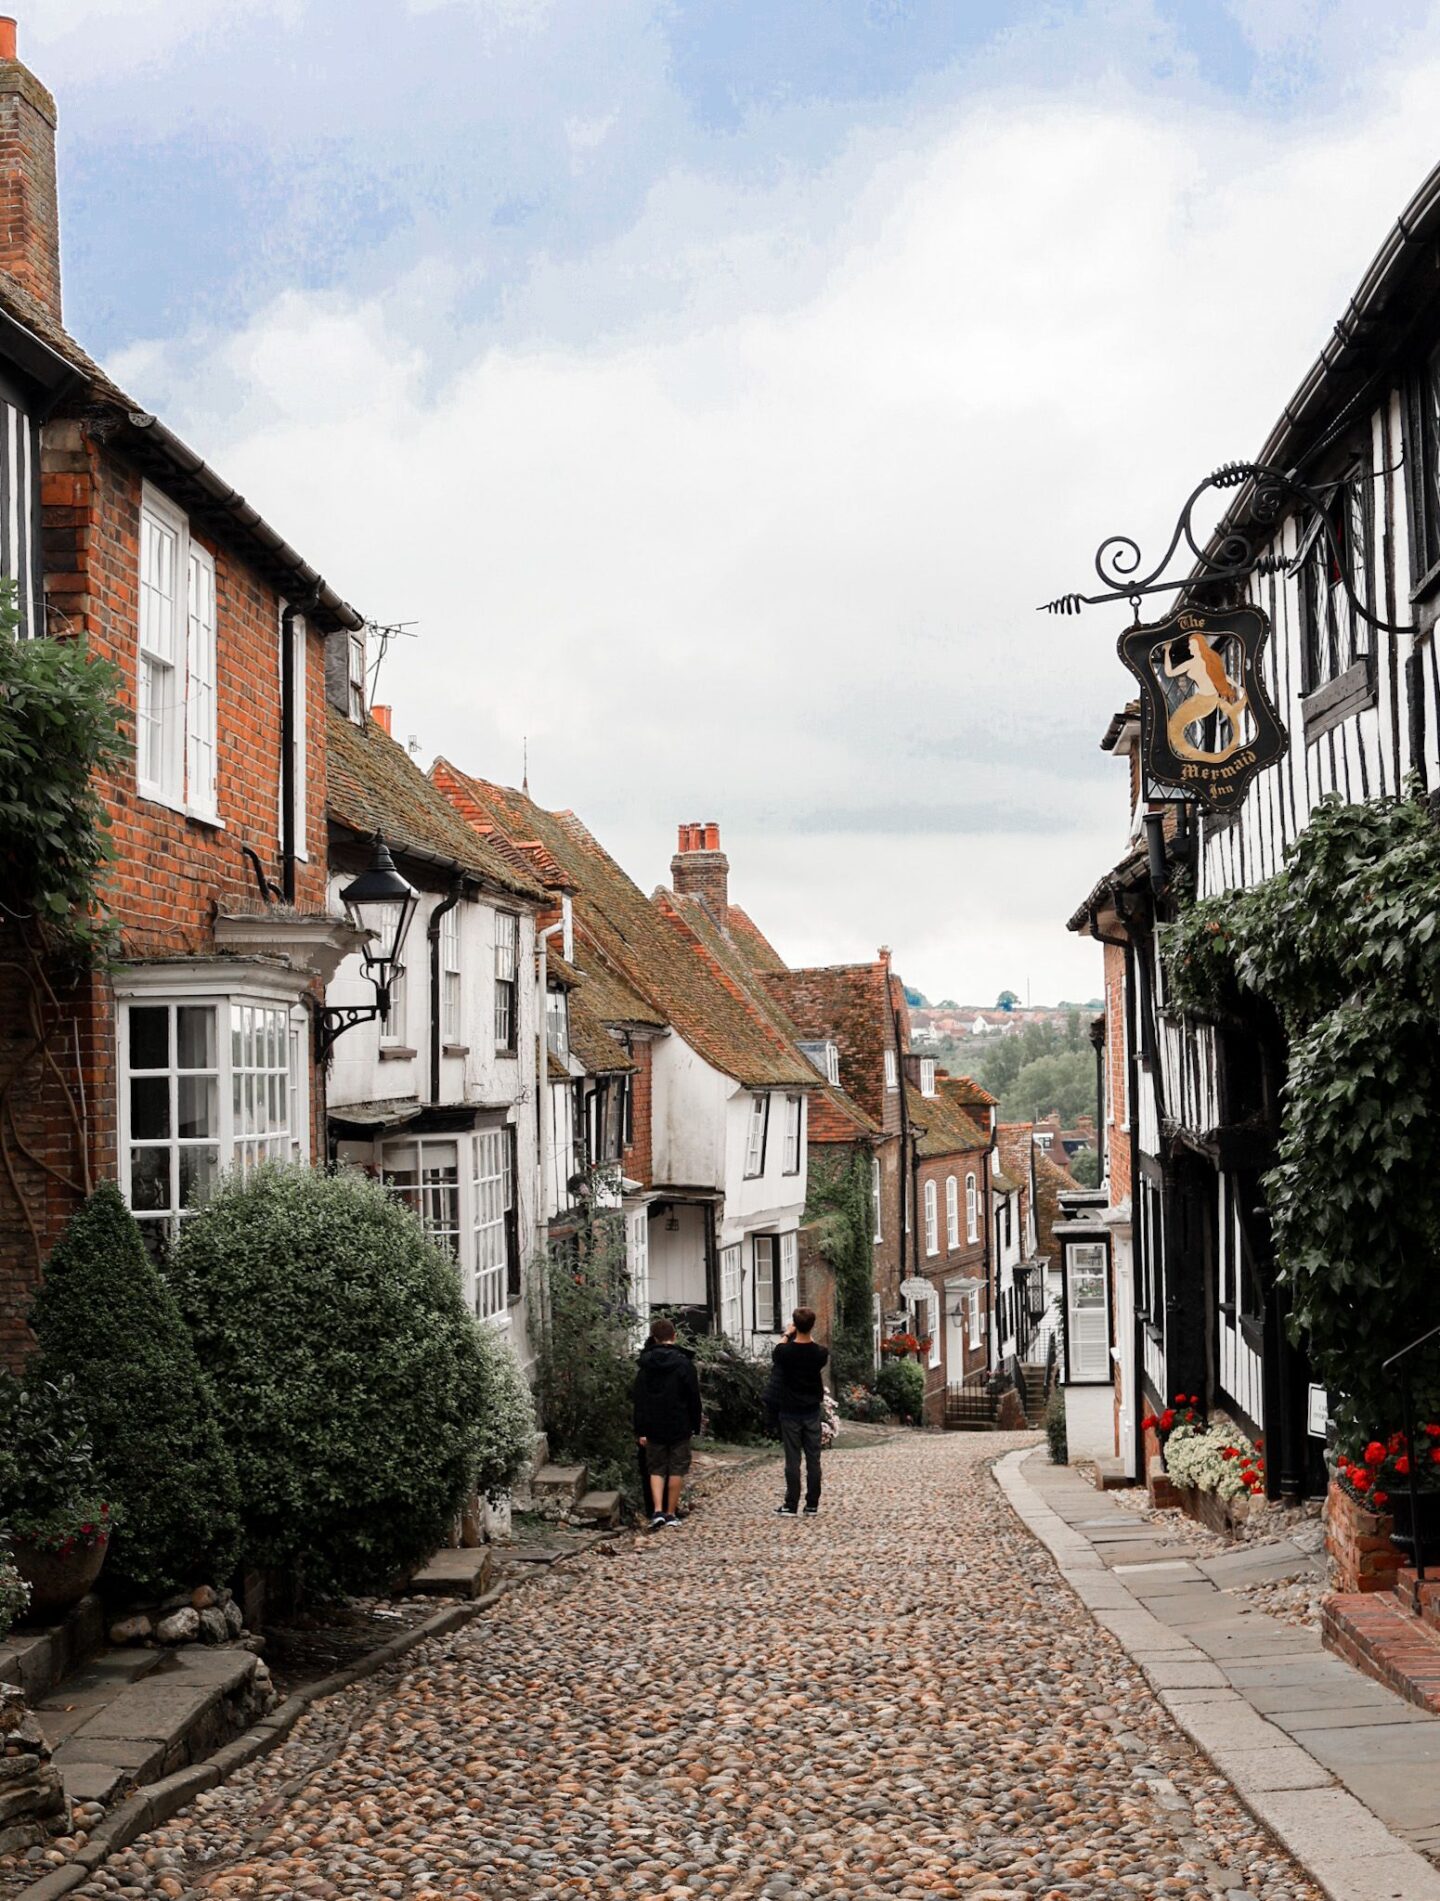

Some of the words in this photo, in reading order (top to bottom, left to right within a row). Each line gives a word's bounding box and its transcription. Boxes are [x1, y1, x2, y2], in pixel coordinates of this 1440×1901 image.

[1178, 614, 1205, 630] The
[1180, 750, 1257, 780] Mermaid
[1209, 783, 1234, 799] Inn
